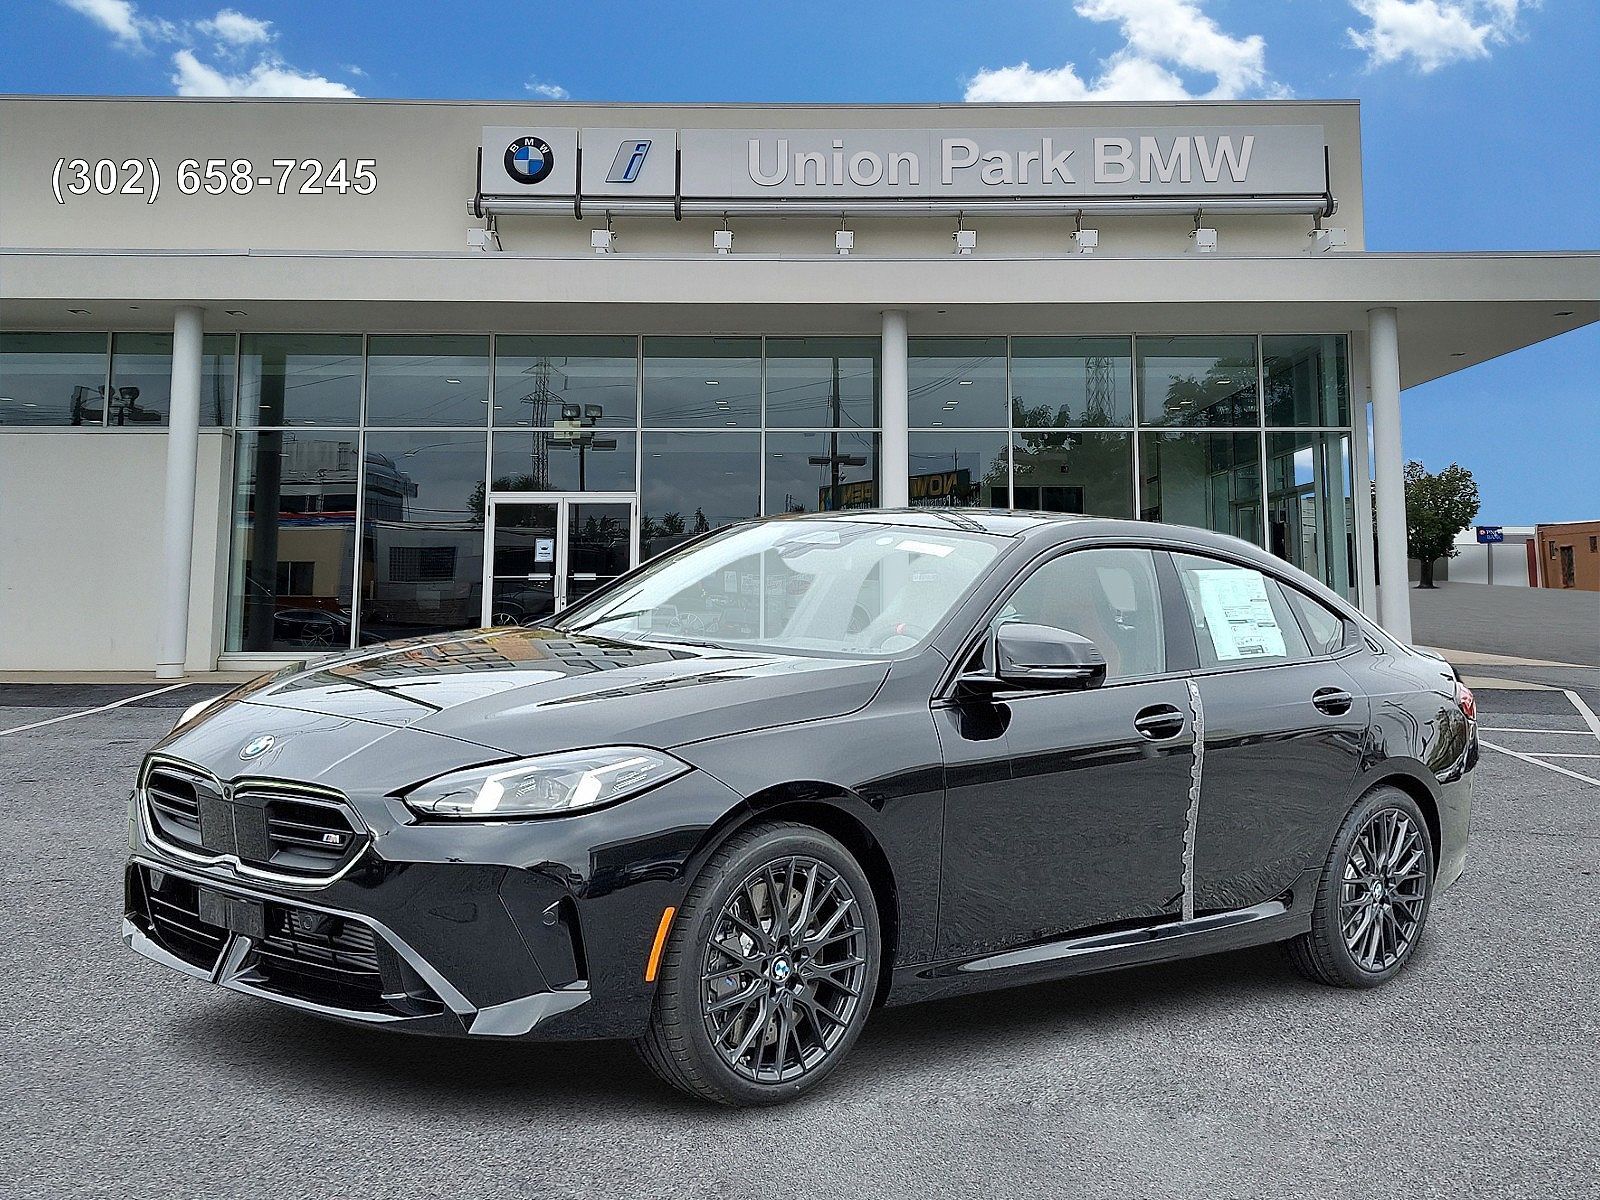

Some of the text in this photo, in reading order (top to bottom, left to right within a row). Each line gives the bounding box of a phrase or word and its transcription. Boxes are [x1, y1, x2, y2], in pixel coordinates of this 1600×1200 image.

[509, 138, 551, 154] BMW
[747, 135, 1256, 187] Union Park BMW
